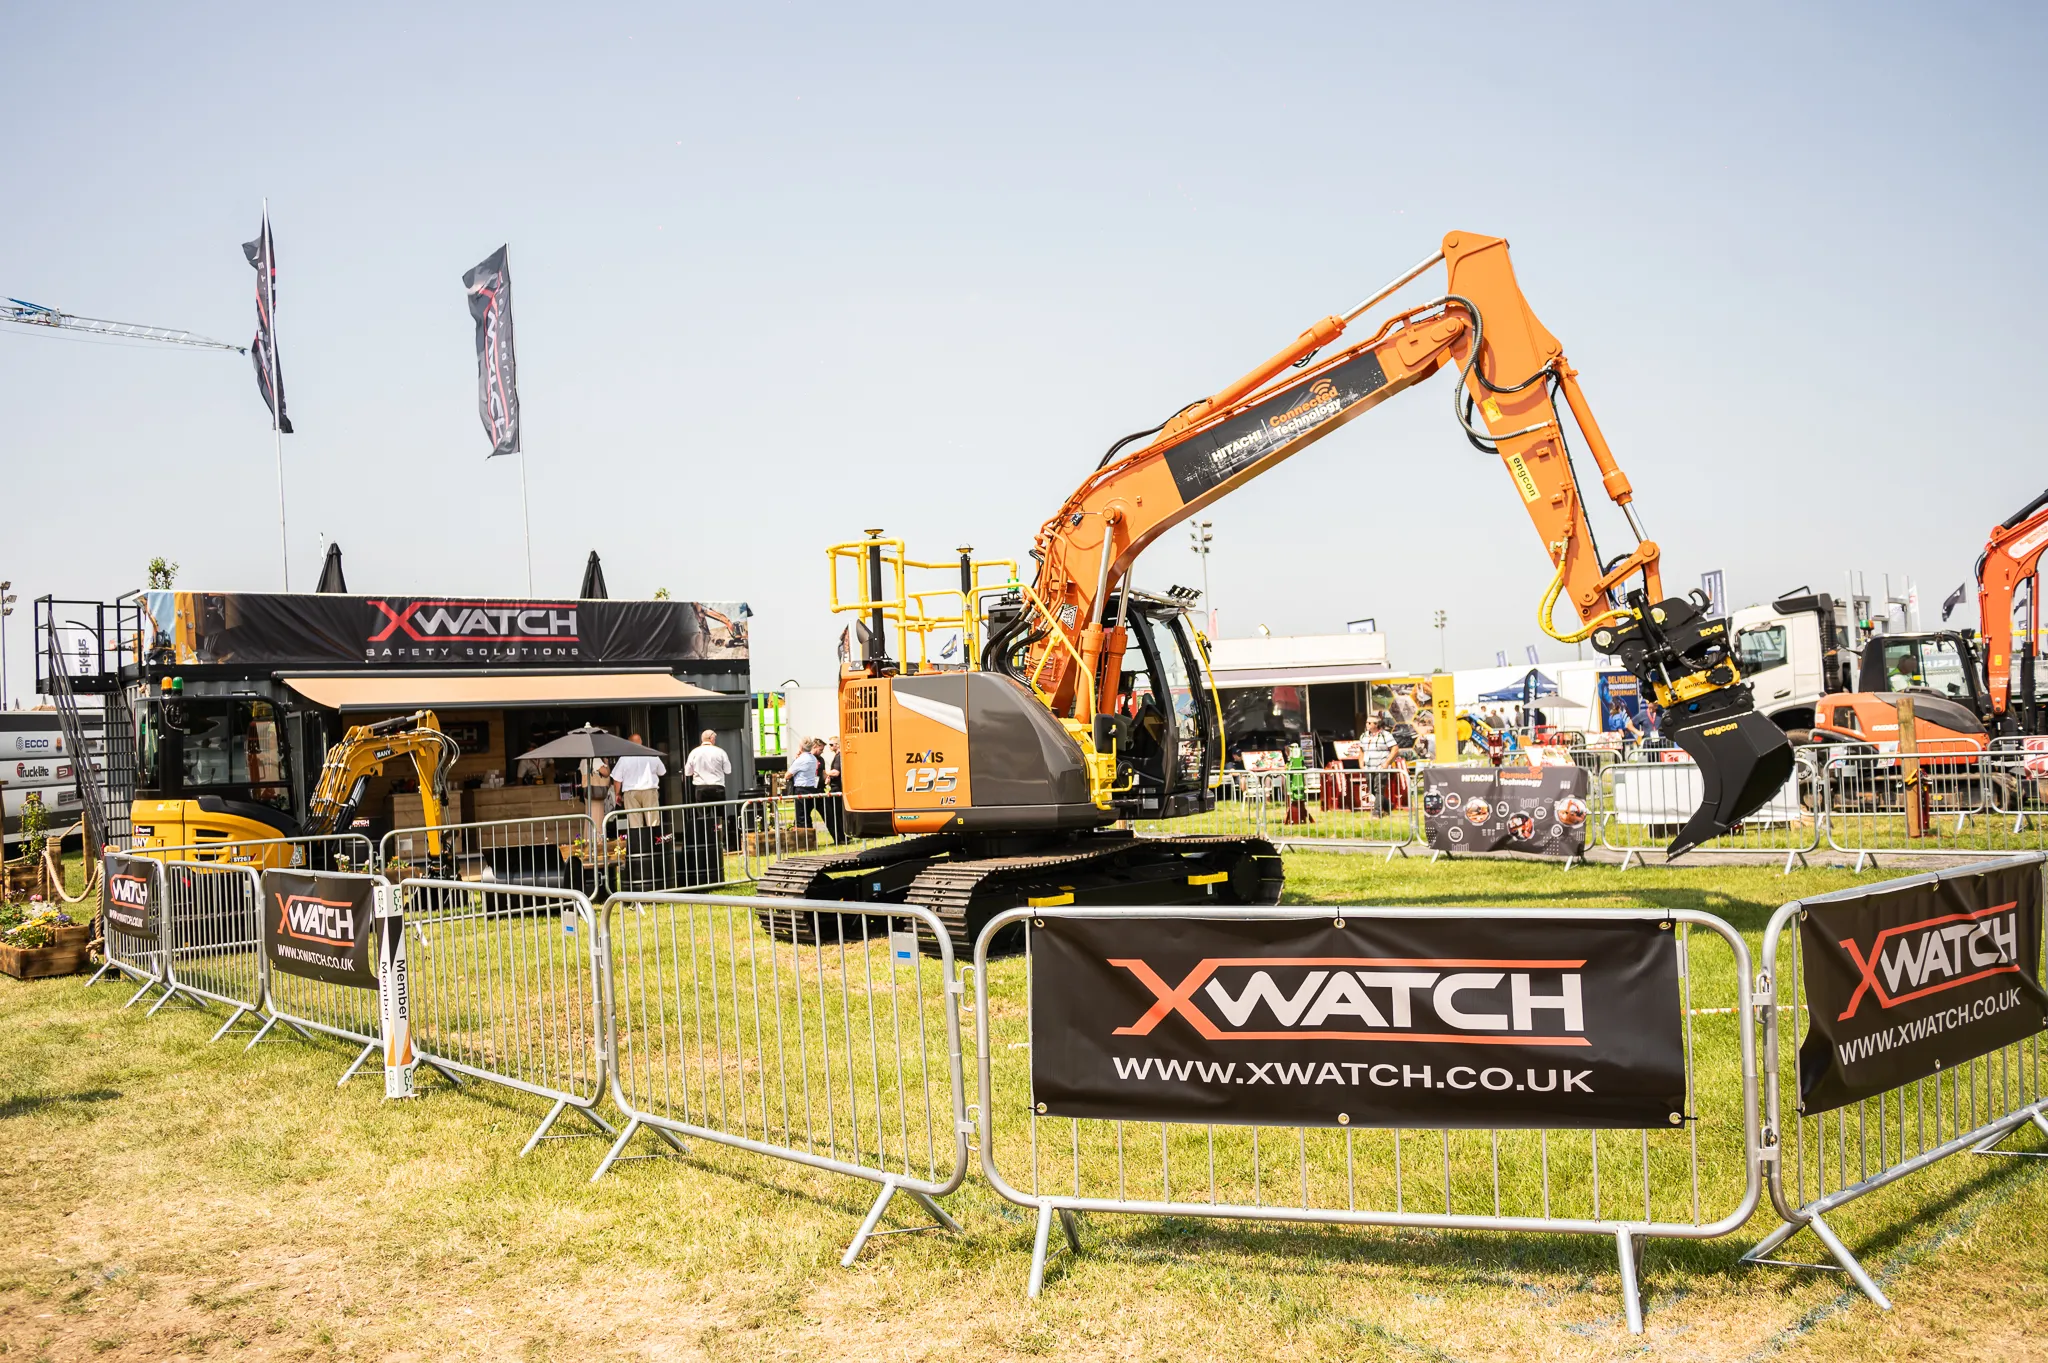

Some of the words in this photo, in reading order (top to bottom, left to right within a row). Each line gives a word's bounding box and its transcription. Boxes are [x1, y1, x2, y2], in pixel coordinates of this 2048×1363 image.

[1269, 386, 1338, 427] Connected
[1211, 430, 1263, 462] HITACHI
[1273, 399, 1341, 437] Technology
[1513, 457, 1536, 497] engcon
[367, 600, 579, 642] XWATCH
[366, 648, 449, 656] SAFETY
[466, 648, 579, 656] SOLUTIONS
[25, 739, 49, 748] ECCO
[1703, 722, 1737, 737] engcon
[376, 750, 392, 759] SANY
[906, 750, 944, 764] ZAXIS
[905, 767, 959, 792] 135
[1461, 774, 1493, 782] HITACHI
[1500, 778, 1541, 787] Technology
[275, 893, 355, 947] XWATCH
[277, 943, 356, 972] WWW.XWATCH.CO.UK
[1837, 901, 2021, 1021] XWATCH
[396, 959, 408, 1021] Member
[1106, 958, 1593, 1046] XWATCH
[1838, 986, 2022, 1066] WWW.XWATCH.CO.UK
[1112, 1056, 1595, 1094] WWW.XWATCH.CO.UK
